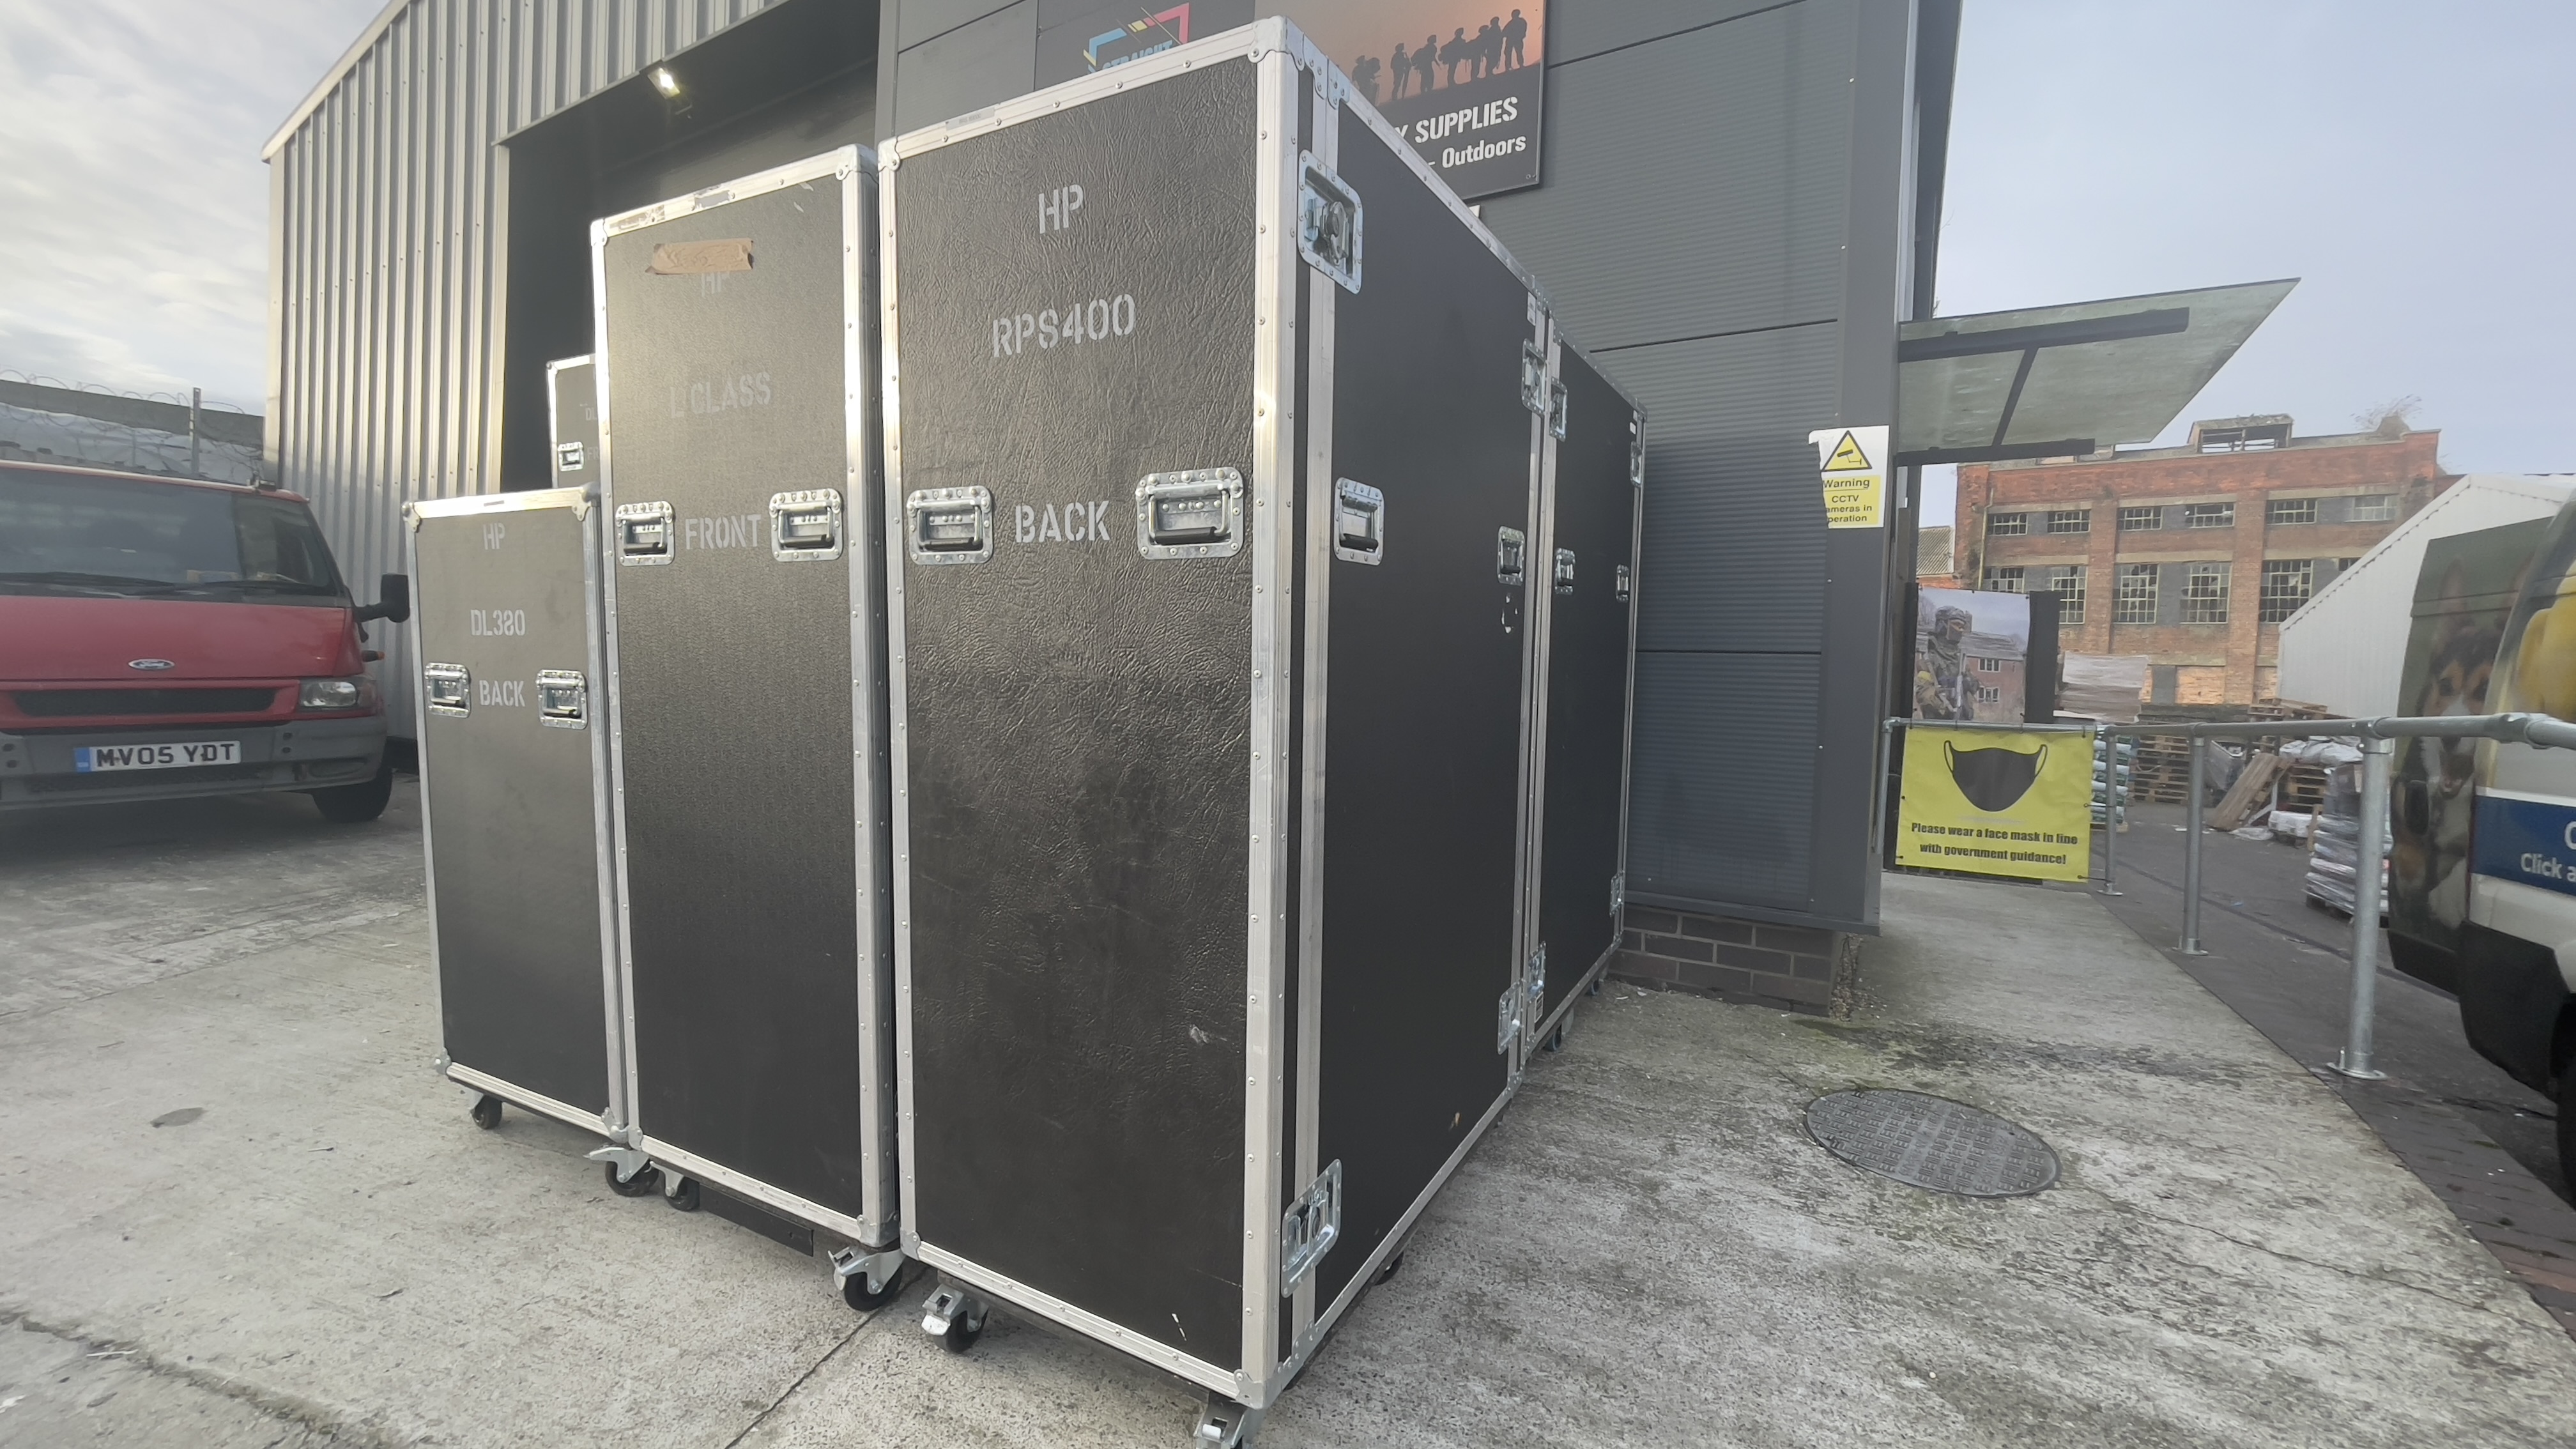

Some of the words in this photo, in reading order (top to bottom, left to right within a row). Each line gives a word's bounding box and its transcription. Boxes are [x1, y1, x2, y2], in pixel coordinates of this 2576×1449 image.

[1414, 96, 1518, 143] SUPPLIES
[1442, 136, 1526, 168] Outdoors
[1038, 185, 1084, 234] HP
[993, 294, 1135, 357] RPS400
[691, 371, 771, 415] CLASS
[1823, 479, 1869, 488] Warning
[686, 514, 763, 550] FRONT
[1015, 500, 1110, 542] BACK
[1828, 514, 1867, 523] peration
[483, 523, 505, 549] HP
[479, 680, 526, 707] BACK
[96, 746, 174, 767] MV05
[183, 744, 234, 762] YDT
[1912, 822, 1945, 835] Please
[1948, 828, 1973, 837] wear
[1976, 829, 1982, 838] a
[1985, 829, 2008, 839] face
[2011, 831, 2041, 841] mask
[2043, 832, 2053, 843] in
[2056, 833, 2078, 845] line
[1920, 843, 1942, 854] with
[1944, 845, 2008, 860] government
[2010, 850, 2066, 864] guidance!
[2521, 853, 2562, 879] Click
